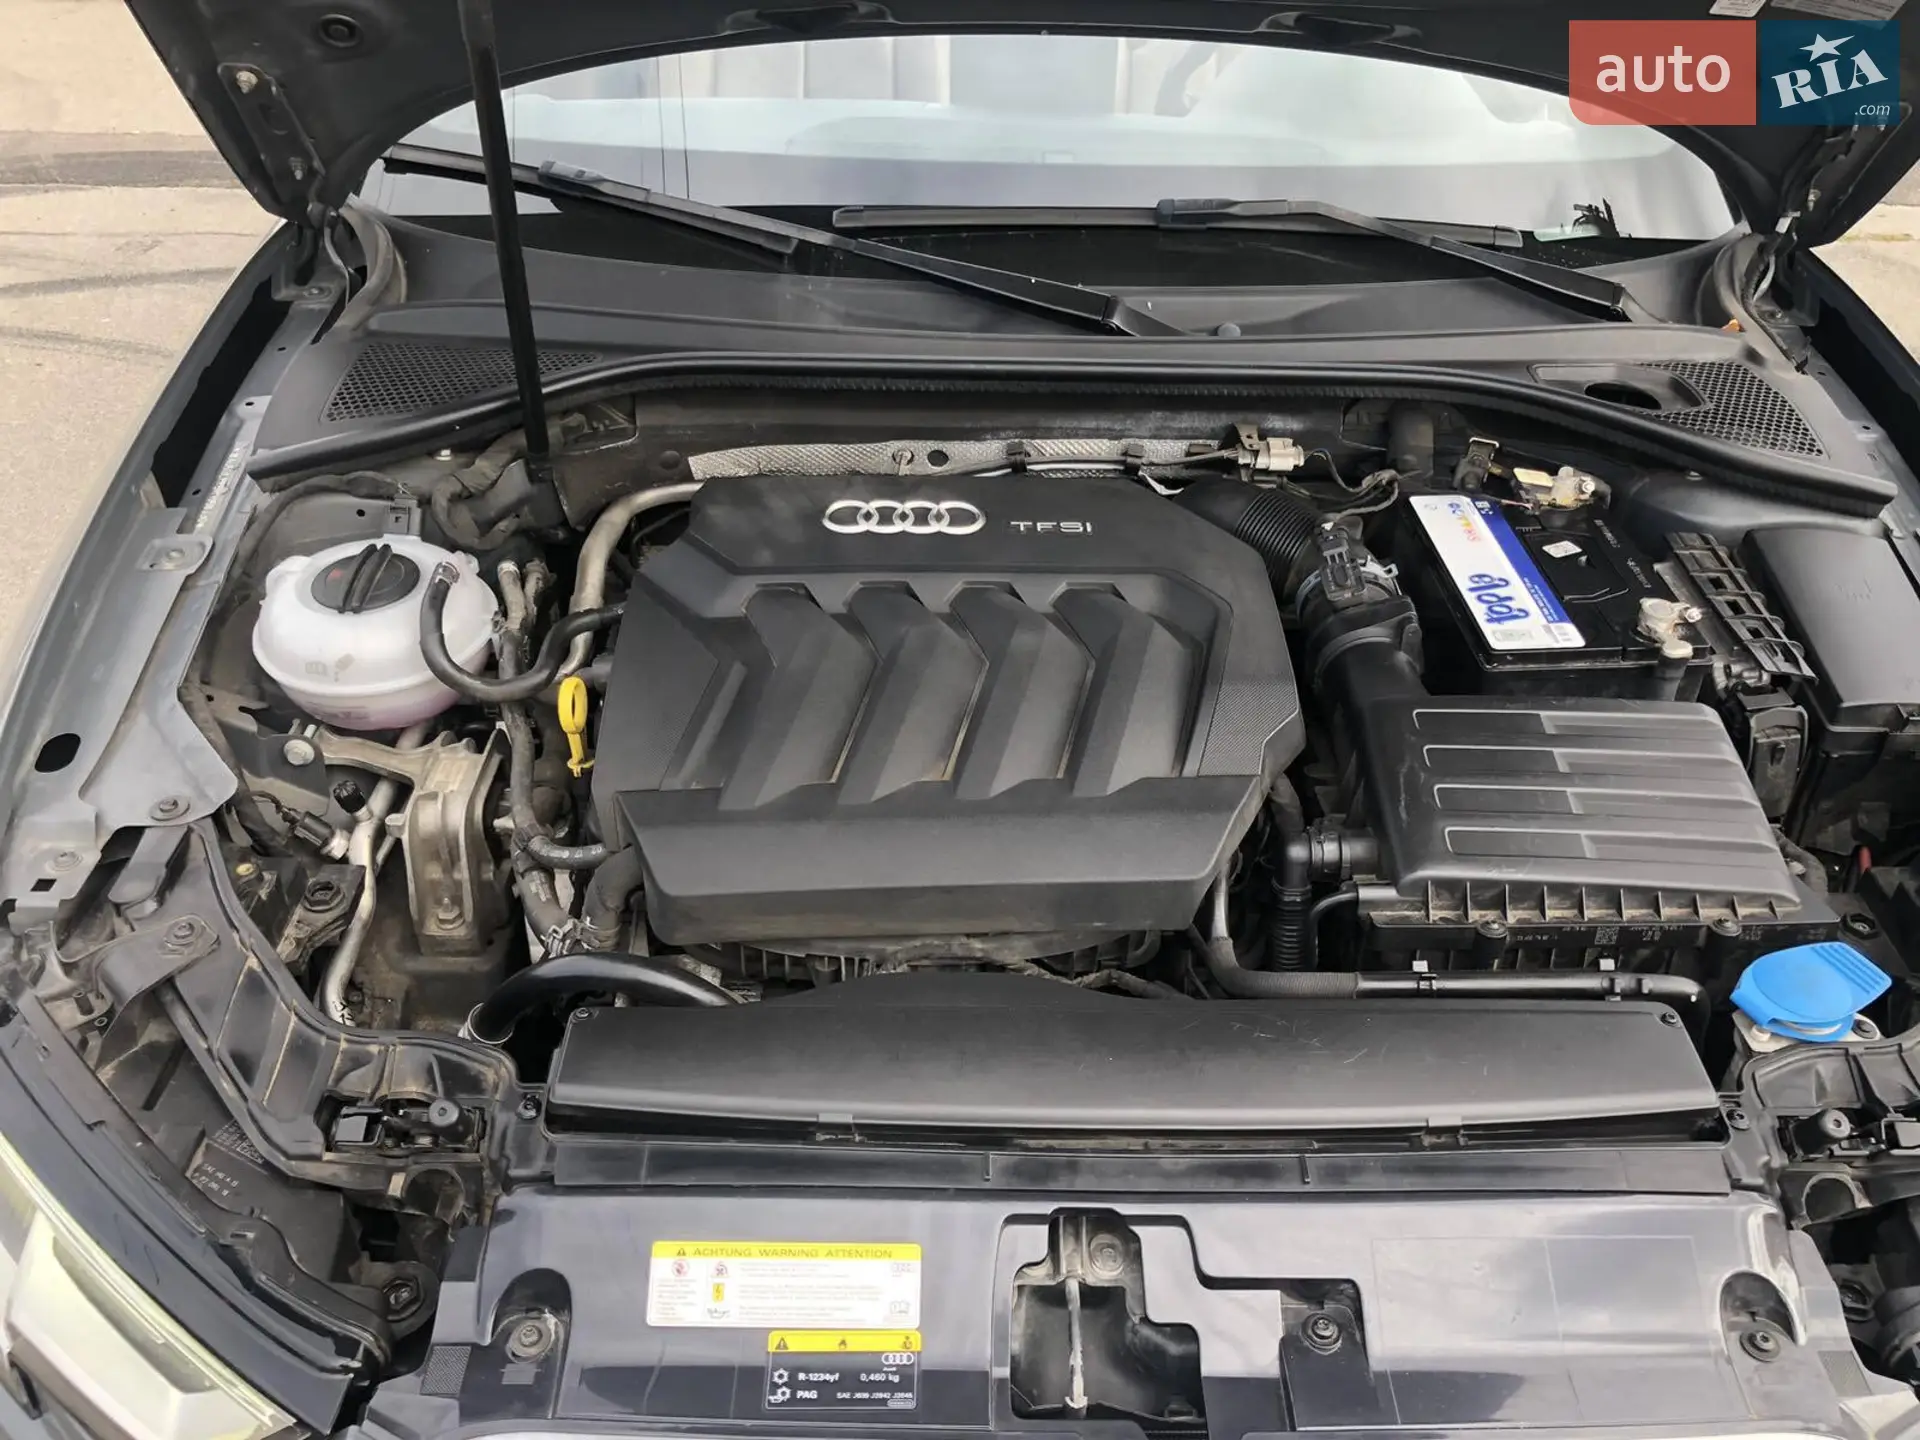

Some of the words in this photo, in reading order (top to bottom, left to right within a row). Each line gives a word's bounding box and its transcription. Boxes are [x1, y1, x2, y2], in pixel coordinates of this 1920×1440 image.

[1010, 521, 1092, 532] TFSI
[1467, 573, 1529, 624] topla
[693, 1247, 751, 1257] ACHTUNG
[758, 1248, 819, 1258] WARNING
[824, 1249, 892, 1259] ATTENTION
[798, 1372, 840, 1383] R-1234yf
[888, 1373, 900, 1383] kg
[796, 1390, 818, 1399] PAG
